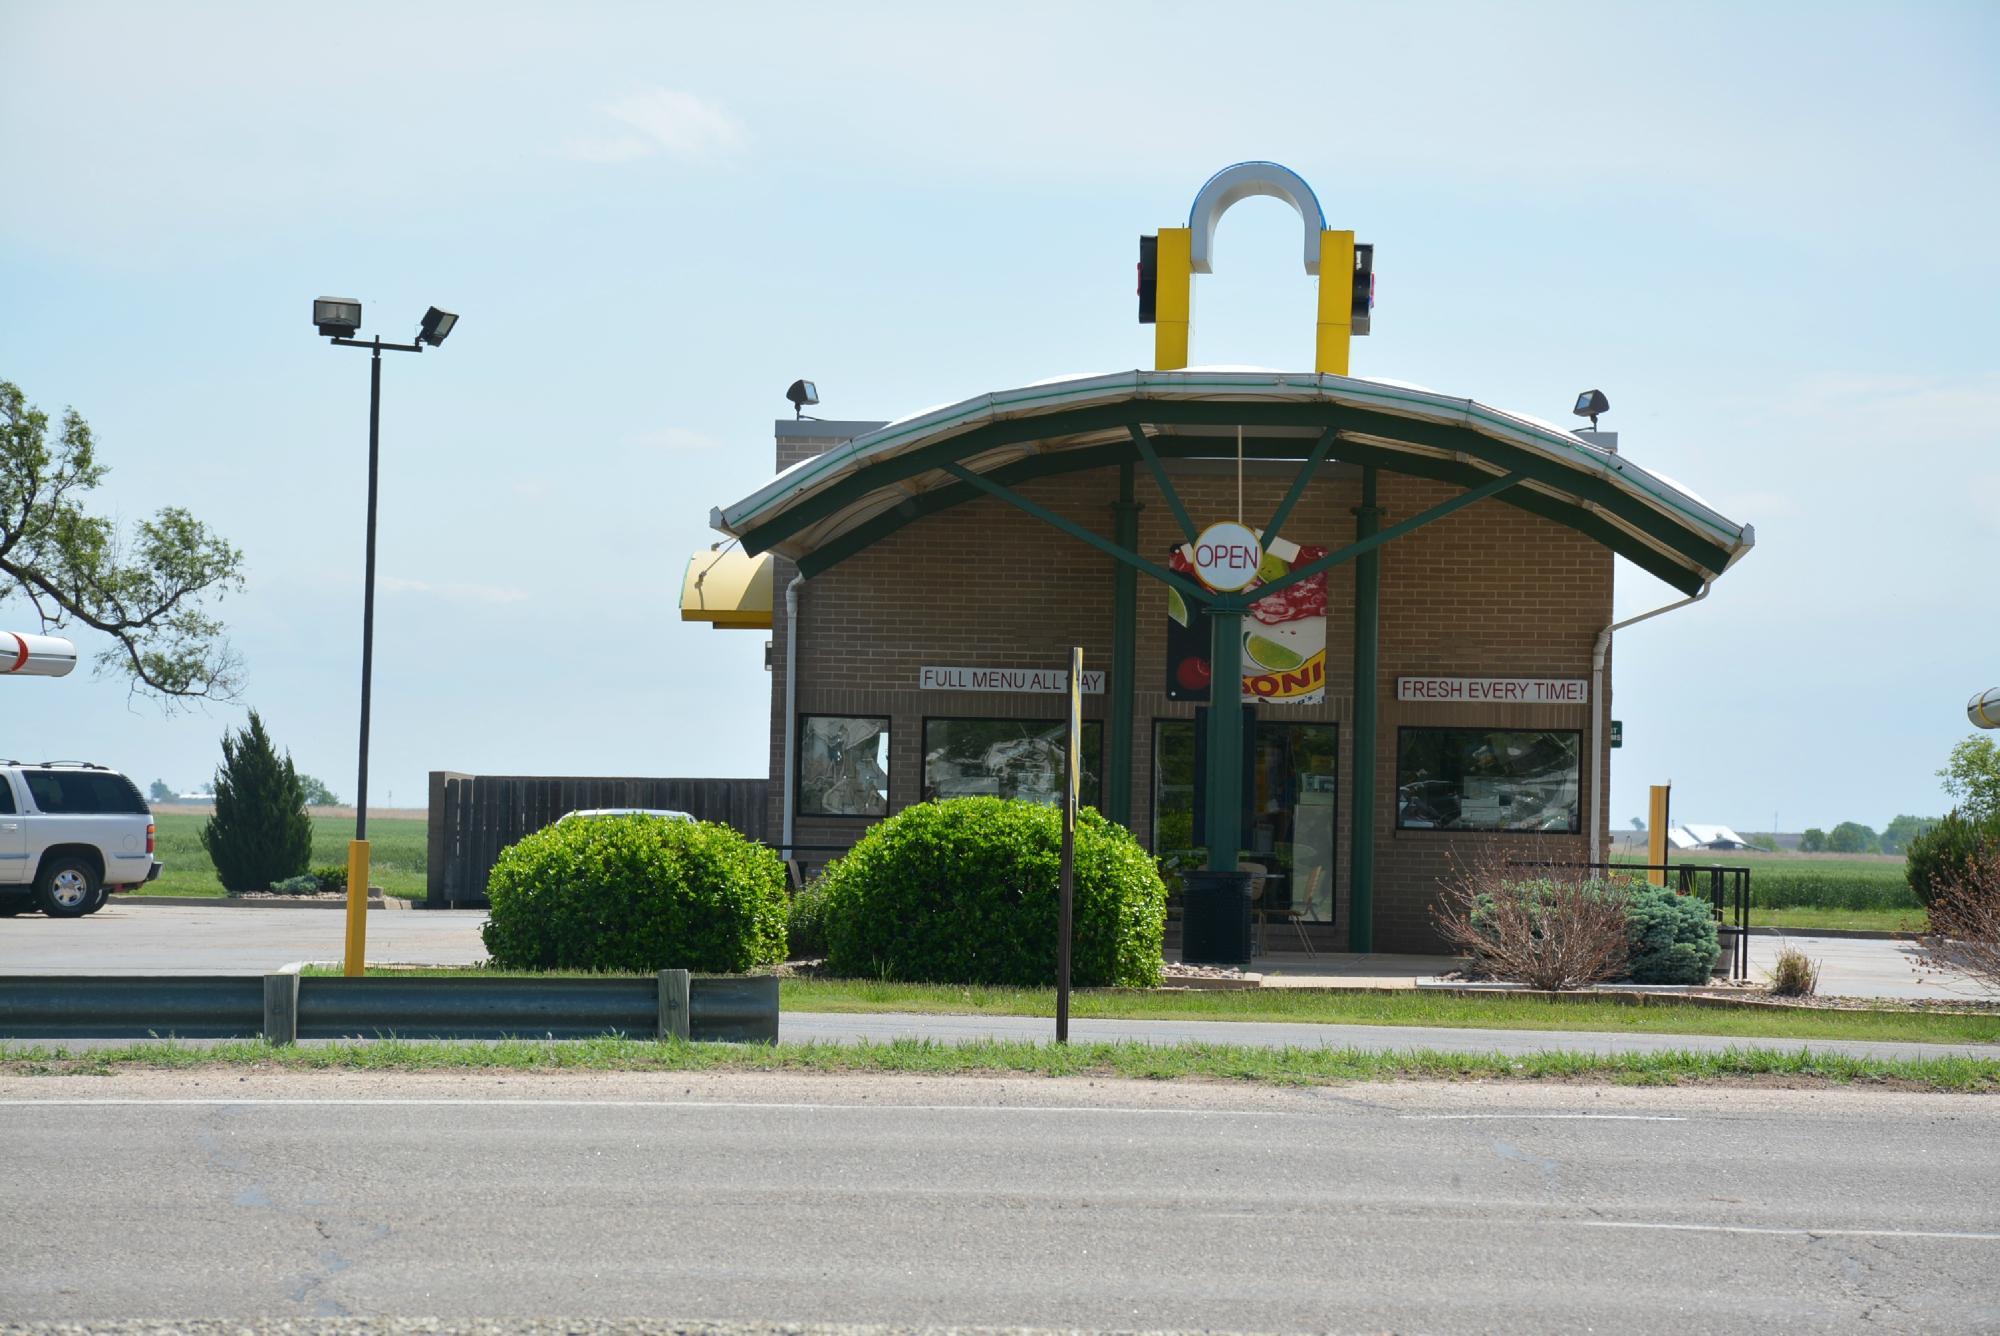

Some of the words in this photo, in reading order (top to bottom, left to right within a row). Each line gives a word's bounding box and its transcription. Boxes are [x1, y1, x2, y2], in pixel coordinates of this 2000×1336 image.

[1195, 544, 1258, 569] OPEN
[924, 670, 966, 688] FULL
[972, 671, 1025, 689] MENU
[1030, 673, 1061, 690] ALL
[1069, 673, 1102, 691] AY
[1402, 680, 1462, 698] FRESH
[1468, 681, 1529, 699] EVERY
[1534, 682, 1584, 700] TIME!
